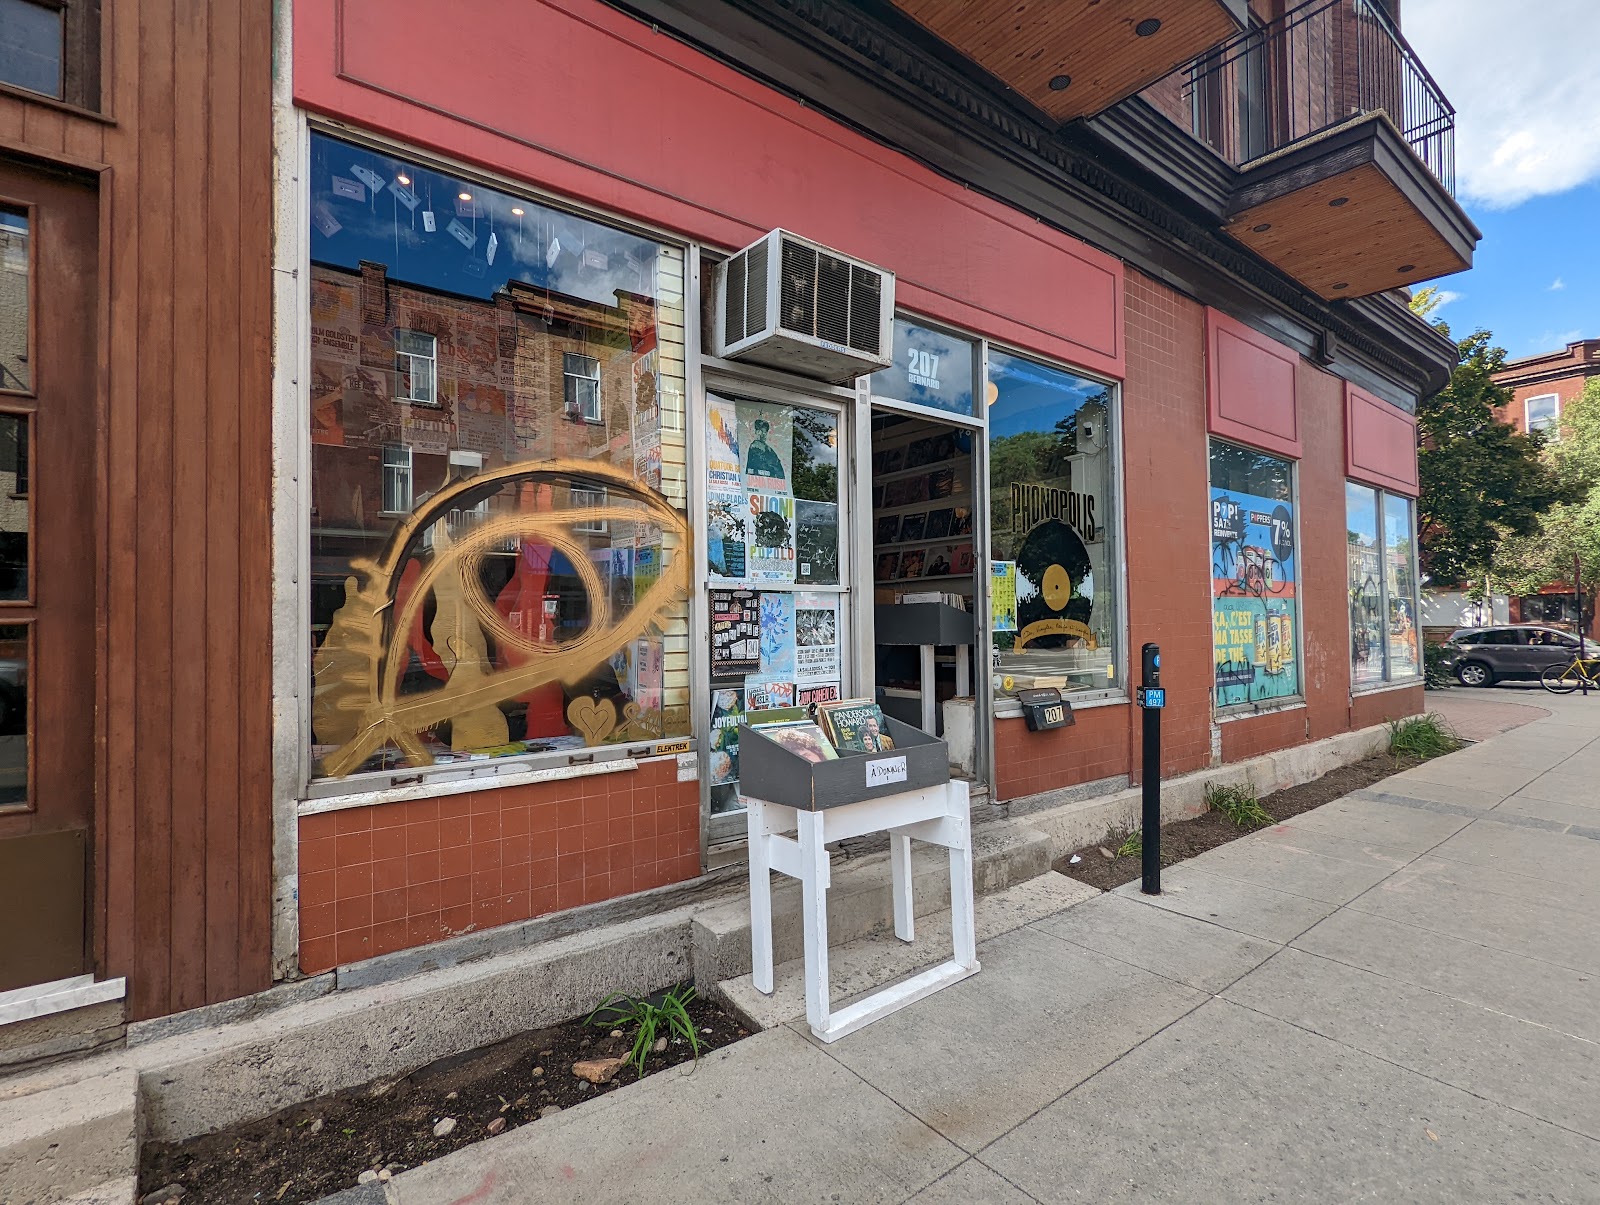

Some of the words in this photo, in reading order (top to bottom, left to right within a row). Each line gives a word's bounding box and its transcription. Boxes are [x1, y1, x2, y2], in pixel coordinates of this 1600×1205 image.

[326, 329, 358, 344] GOLDSTEIN
[323, 338, 354, 351] ENSEMBLE
[908, 348, 939, 379] 207
[909, 373, 940, 390] BERNARD
[709, 470, 737, 482] CHRISTIAN
[708, 492, 725, 503] DING
[727, 493, 748, 505] PLACES
[1011, 482, 1095, 542] PHONOPOLIS
[1273, 519, 1290, 545] 7%
[1231, 611, 1252, 626] C'EST
[1215, 630, 1228, 645] MA
[1230, 629, 1253, 644] TASSE
[1268, 631, 1279, 647] TEA
[1215, 648, 1227, 663] DE
[812, 687, 830, 702] COHEN
[1149, 690, 1161, 698] PM
[837, 708, 874, 719] ANDERSON
[1046, 707, 1061, 722] 207
[836, 717, 866, 728] HOWARD
[657, 742, 688, 753] ELEKTREK
[871, 764, 877, 778] À
[877, 762, 906, 777] DONNER
